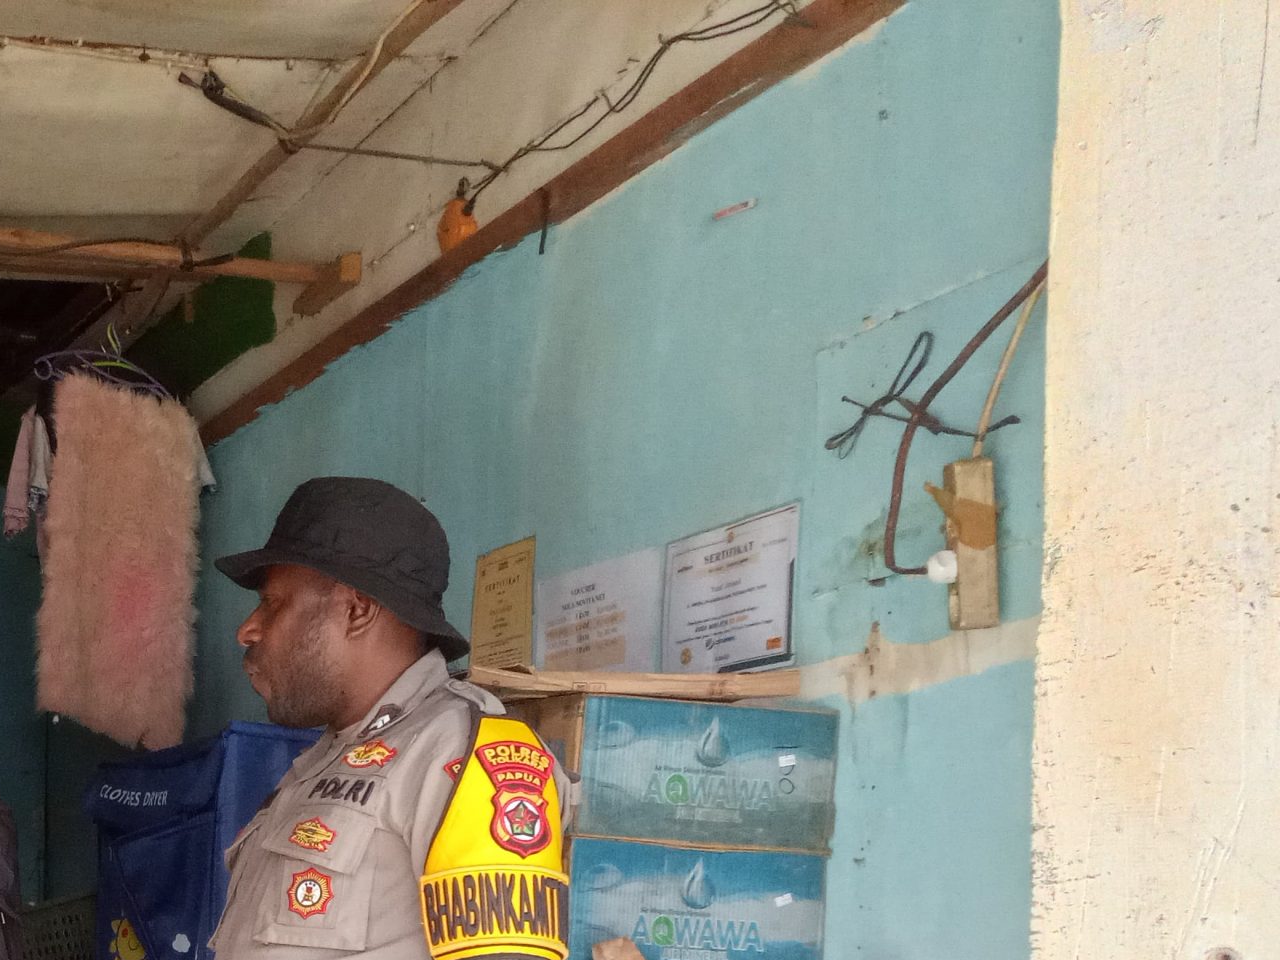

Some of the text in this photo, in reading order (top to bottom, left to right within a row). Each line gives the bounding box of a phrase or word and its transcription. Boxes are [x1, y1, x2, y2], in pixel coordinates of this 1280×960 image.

[704, 541, 755, 564] SERTIFIKAT
[483, 744, 550, 769] POLRES
[308, 776, 375, 806] POLRI
[496, 771, 541, 786] PAPUA
[100, 784, 168, 807] CLOTHES DRYER
[640, 772, 777, 812] AQWAWA
[630, 914, 765, 953] AQWAWA
